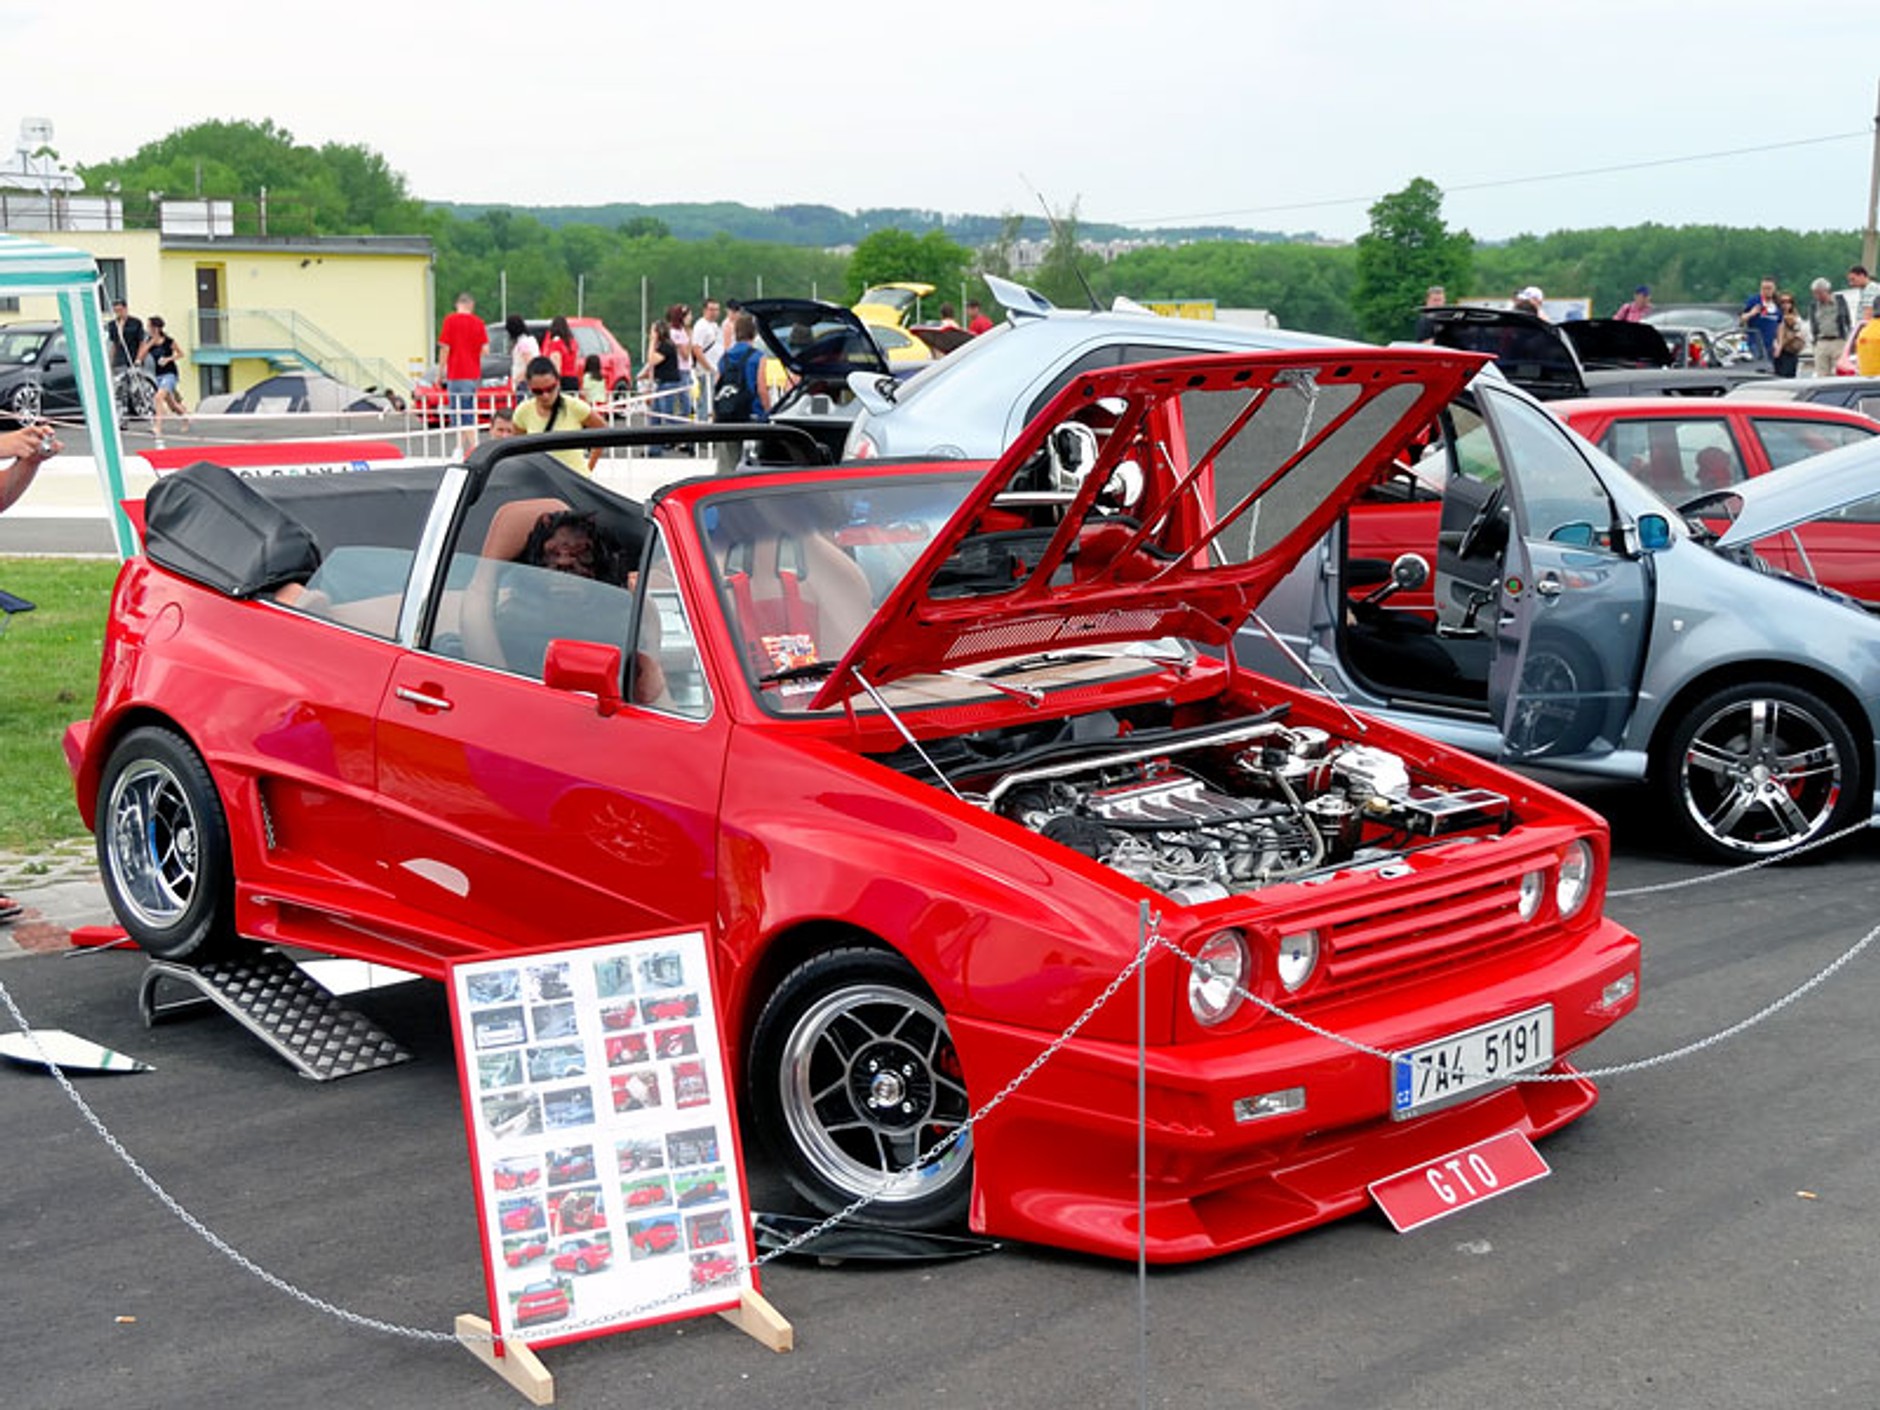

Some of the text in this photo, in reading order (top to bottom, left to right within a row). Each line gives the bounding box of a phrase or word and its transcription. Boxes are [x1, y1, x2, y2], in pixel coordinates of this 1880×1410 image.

[1418, 1020, 1541, 1098] 7A4 5191
[1426, 1153, 1498, 1205] GTO
